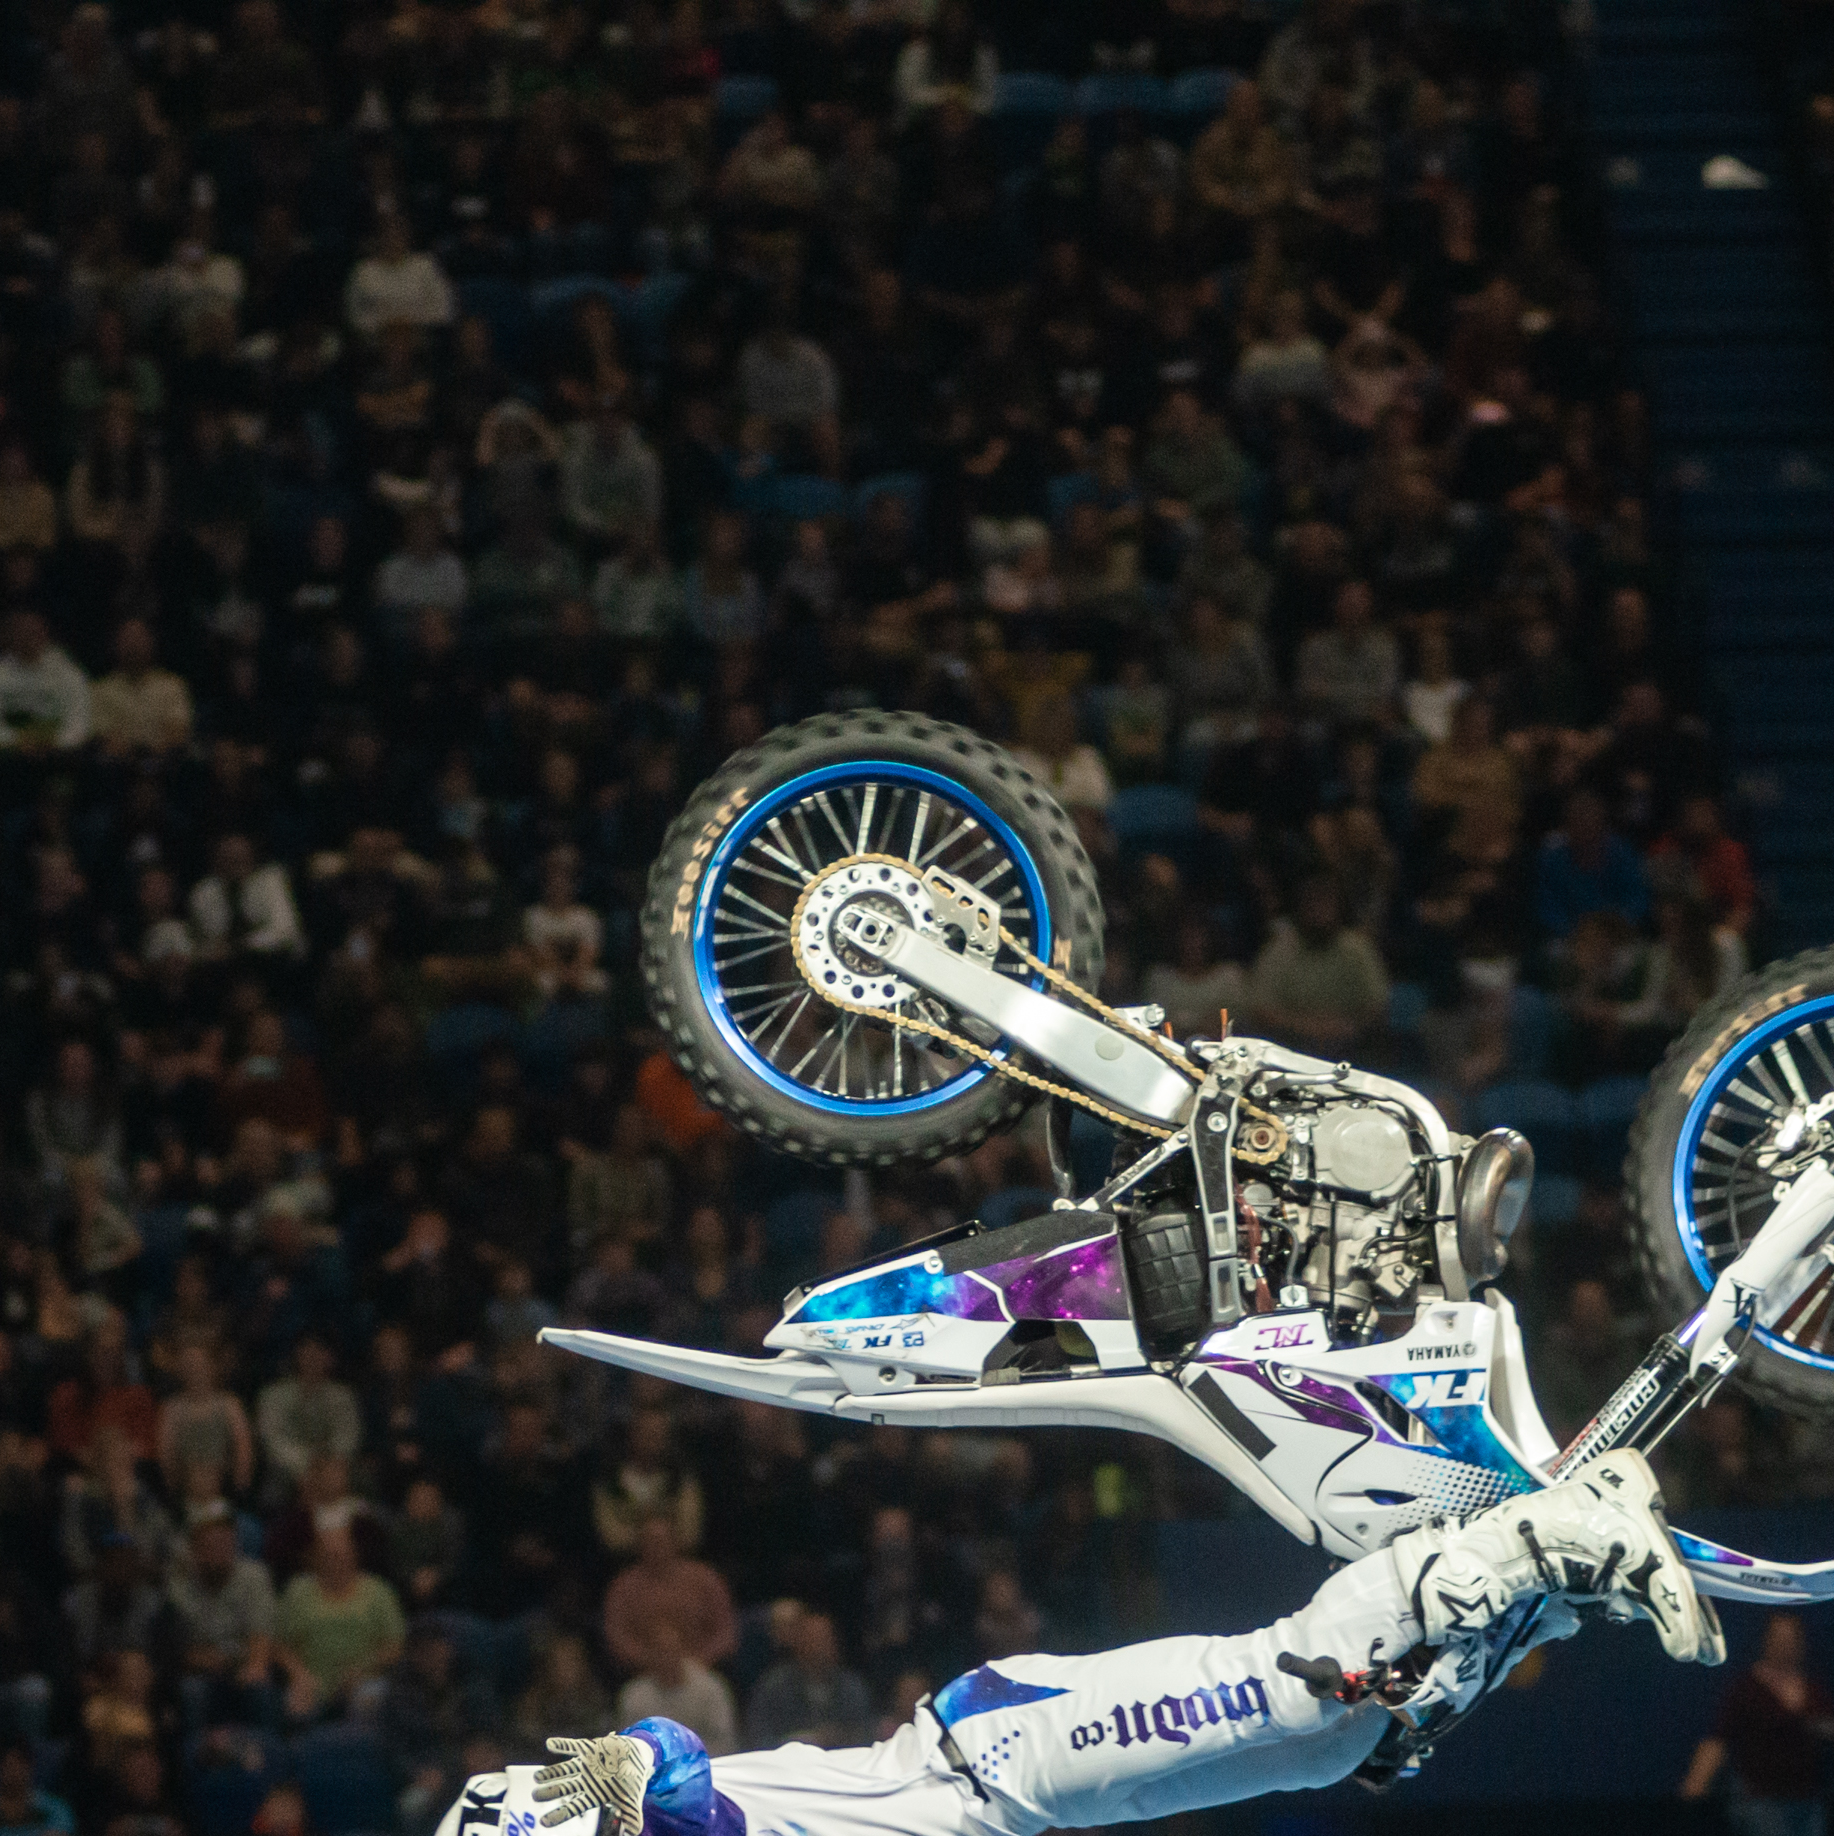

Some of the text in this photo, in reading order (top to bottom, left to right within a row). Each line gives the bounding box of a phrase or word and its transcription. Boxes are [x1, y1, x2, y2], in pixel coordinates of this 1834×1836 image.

[863, 1335, 892, 1349] FK
[1407, 1345, 1461, 1361] YAMAHA
[1410, 1372, 1486, 1407] FK
